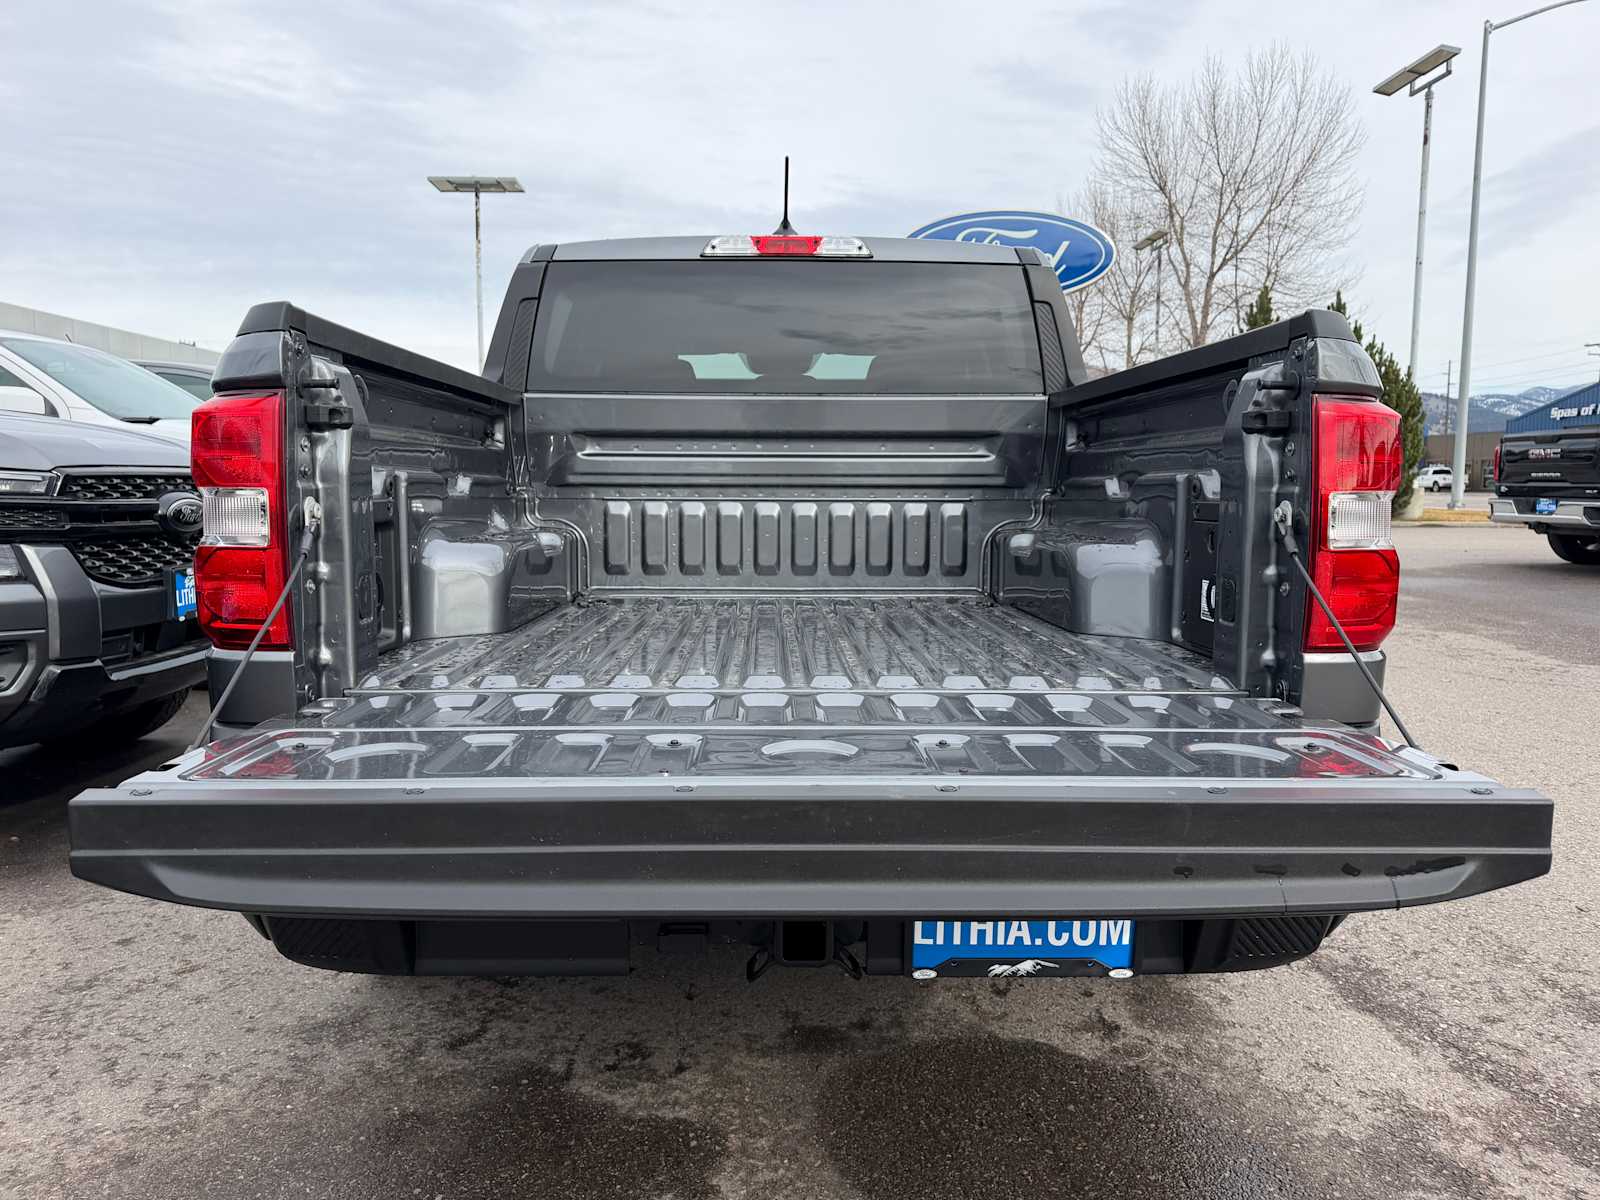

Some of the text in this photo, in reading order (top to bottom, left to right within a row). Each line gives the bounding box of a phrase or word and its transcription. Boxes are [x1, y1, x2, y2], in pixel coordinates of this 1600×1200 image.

[1580, 403, 1596, 416] of
[1528, 448, 1561, 459] GMC
[913, 920, 1131, 946] LITHIA.COM
